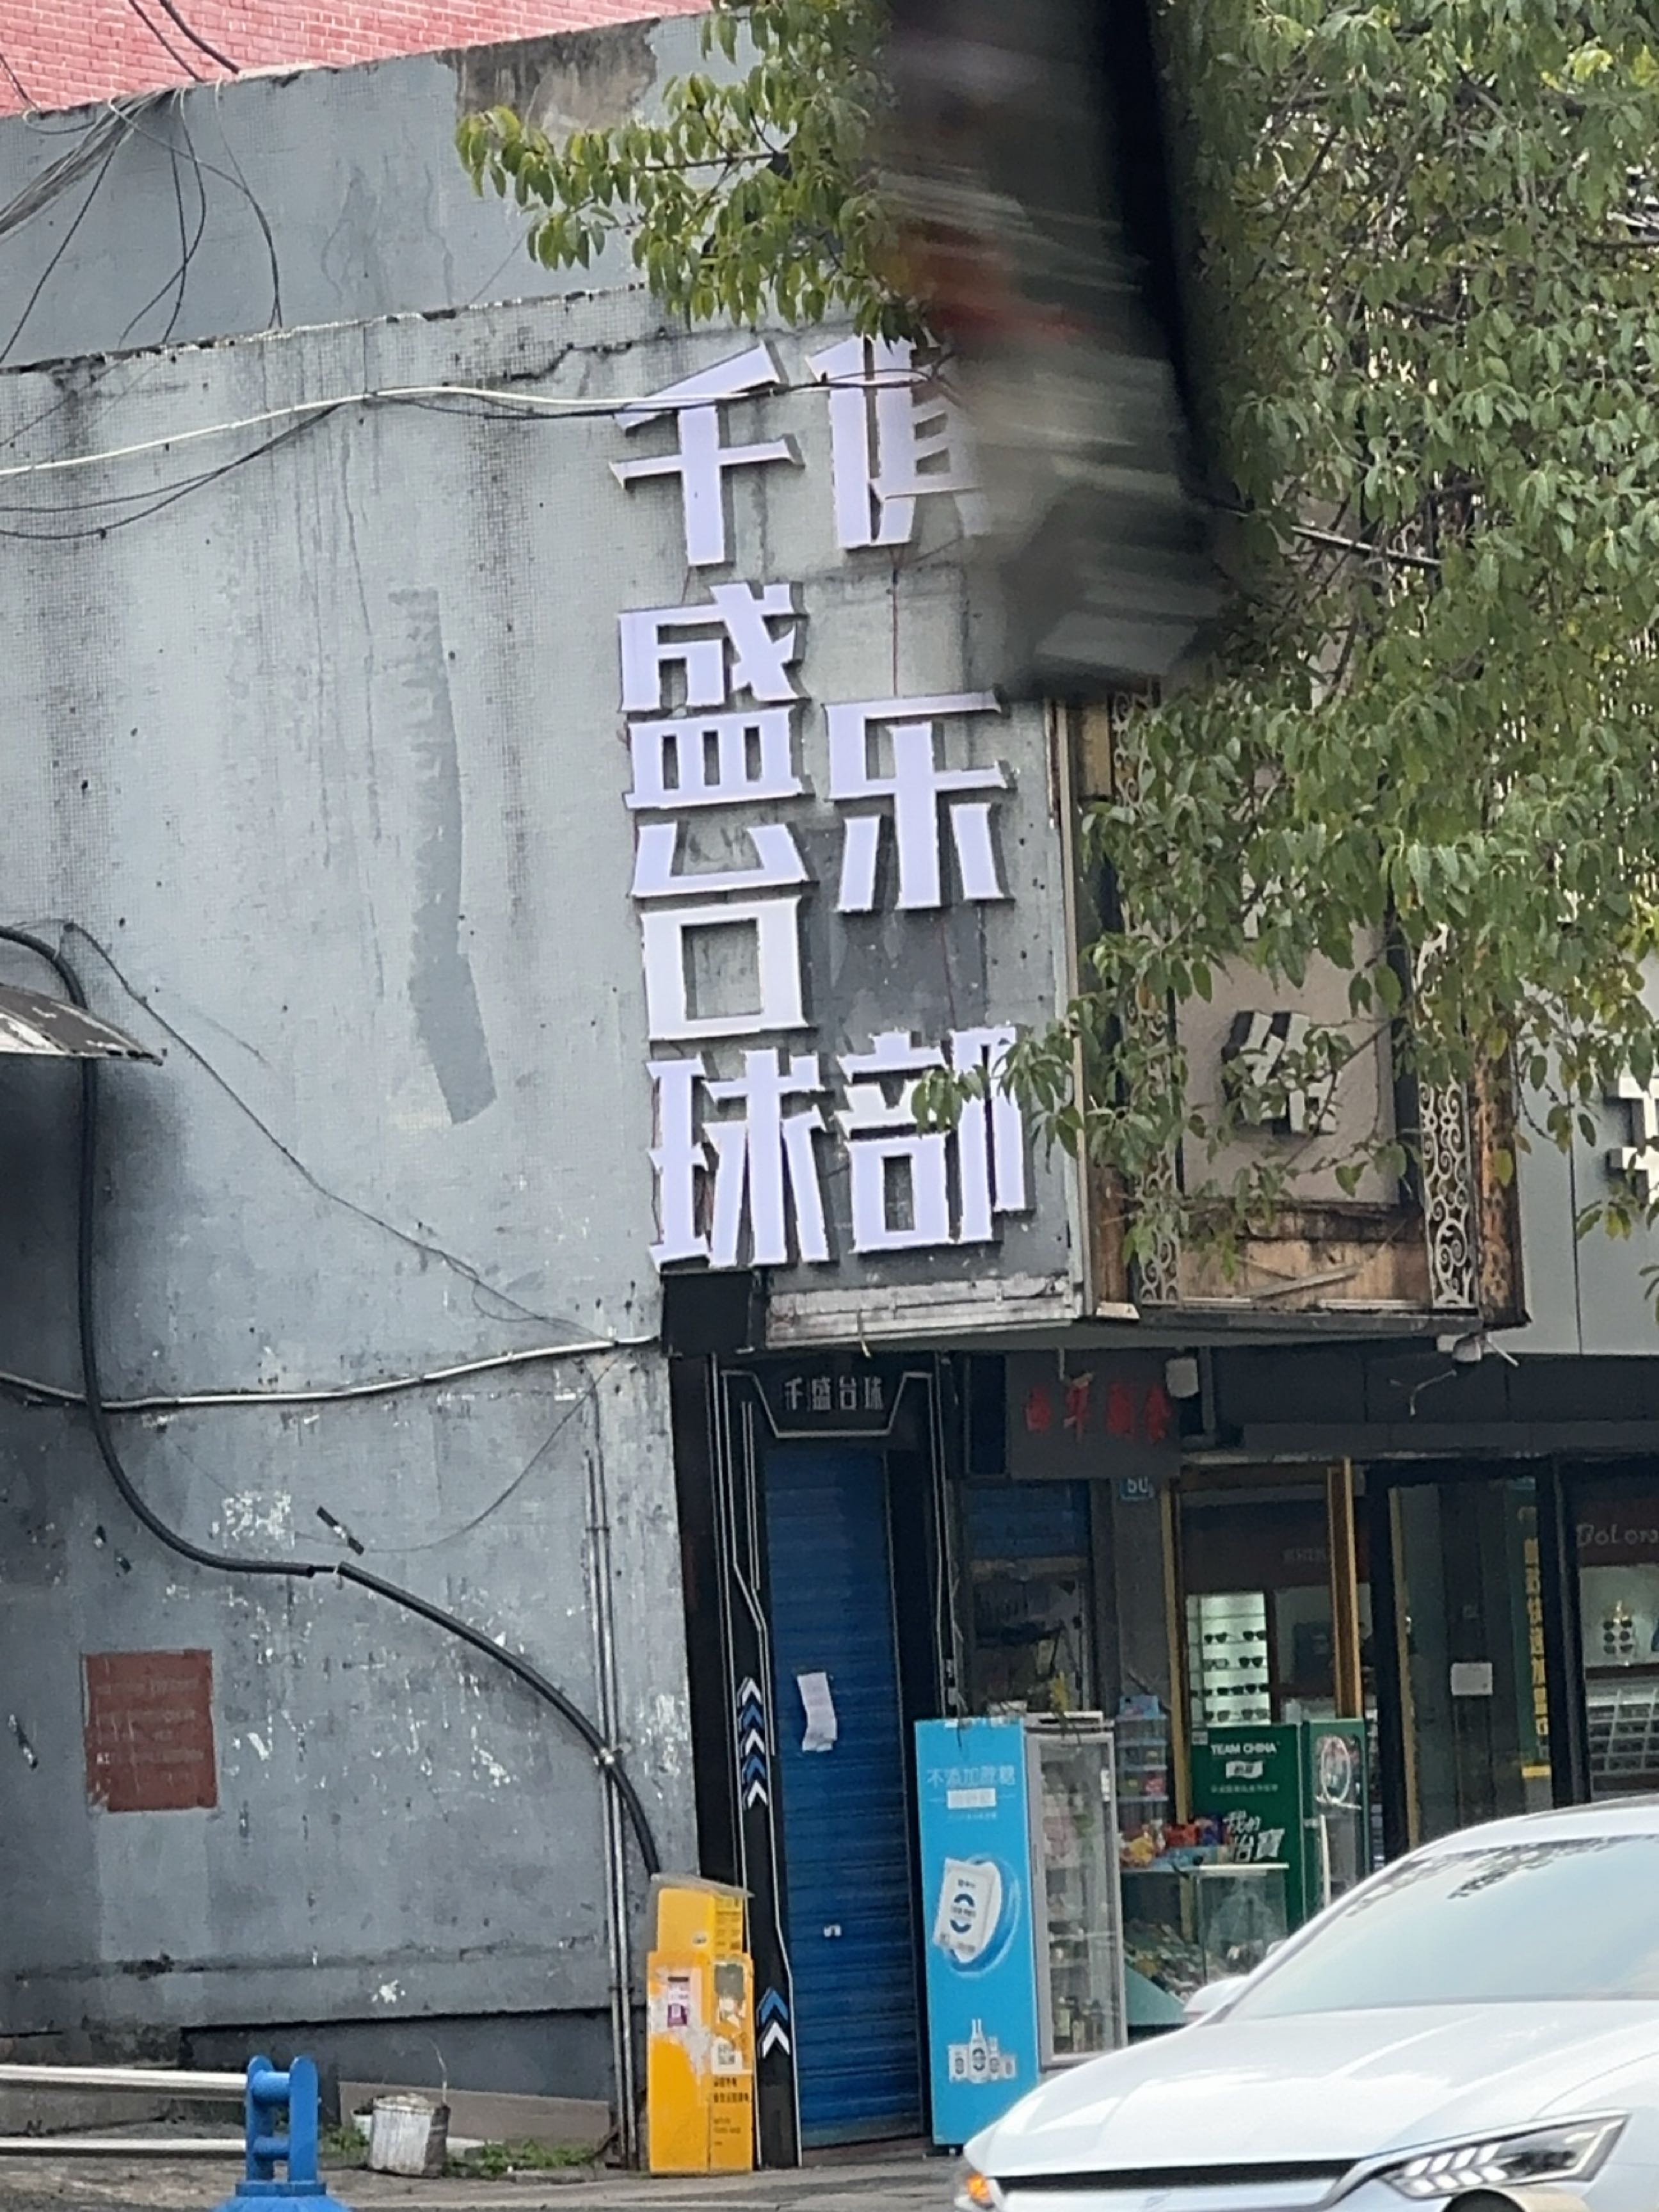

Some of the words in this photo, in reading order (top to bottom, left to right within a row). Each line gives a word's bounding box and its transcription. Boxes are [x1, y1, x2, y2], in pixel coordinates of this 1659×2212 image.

[608, 341, 831, 1272] 千盛台球
[784, 1377, 884, 1411] 千盛台球
[1211, 1743, 1240, 1756] TEAM
[1243, 1742, 1278, 1754] CHINA
